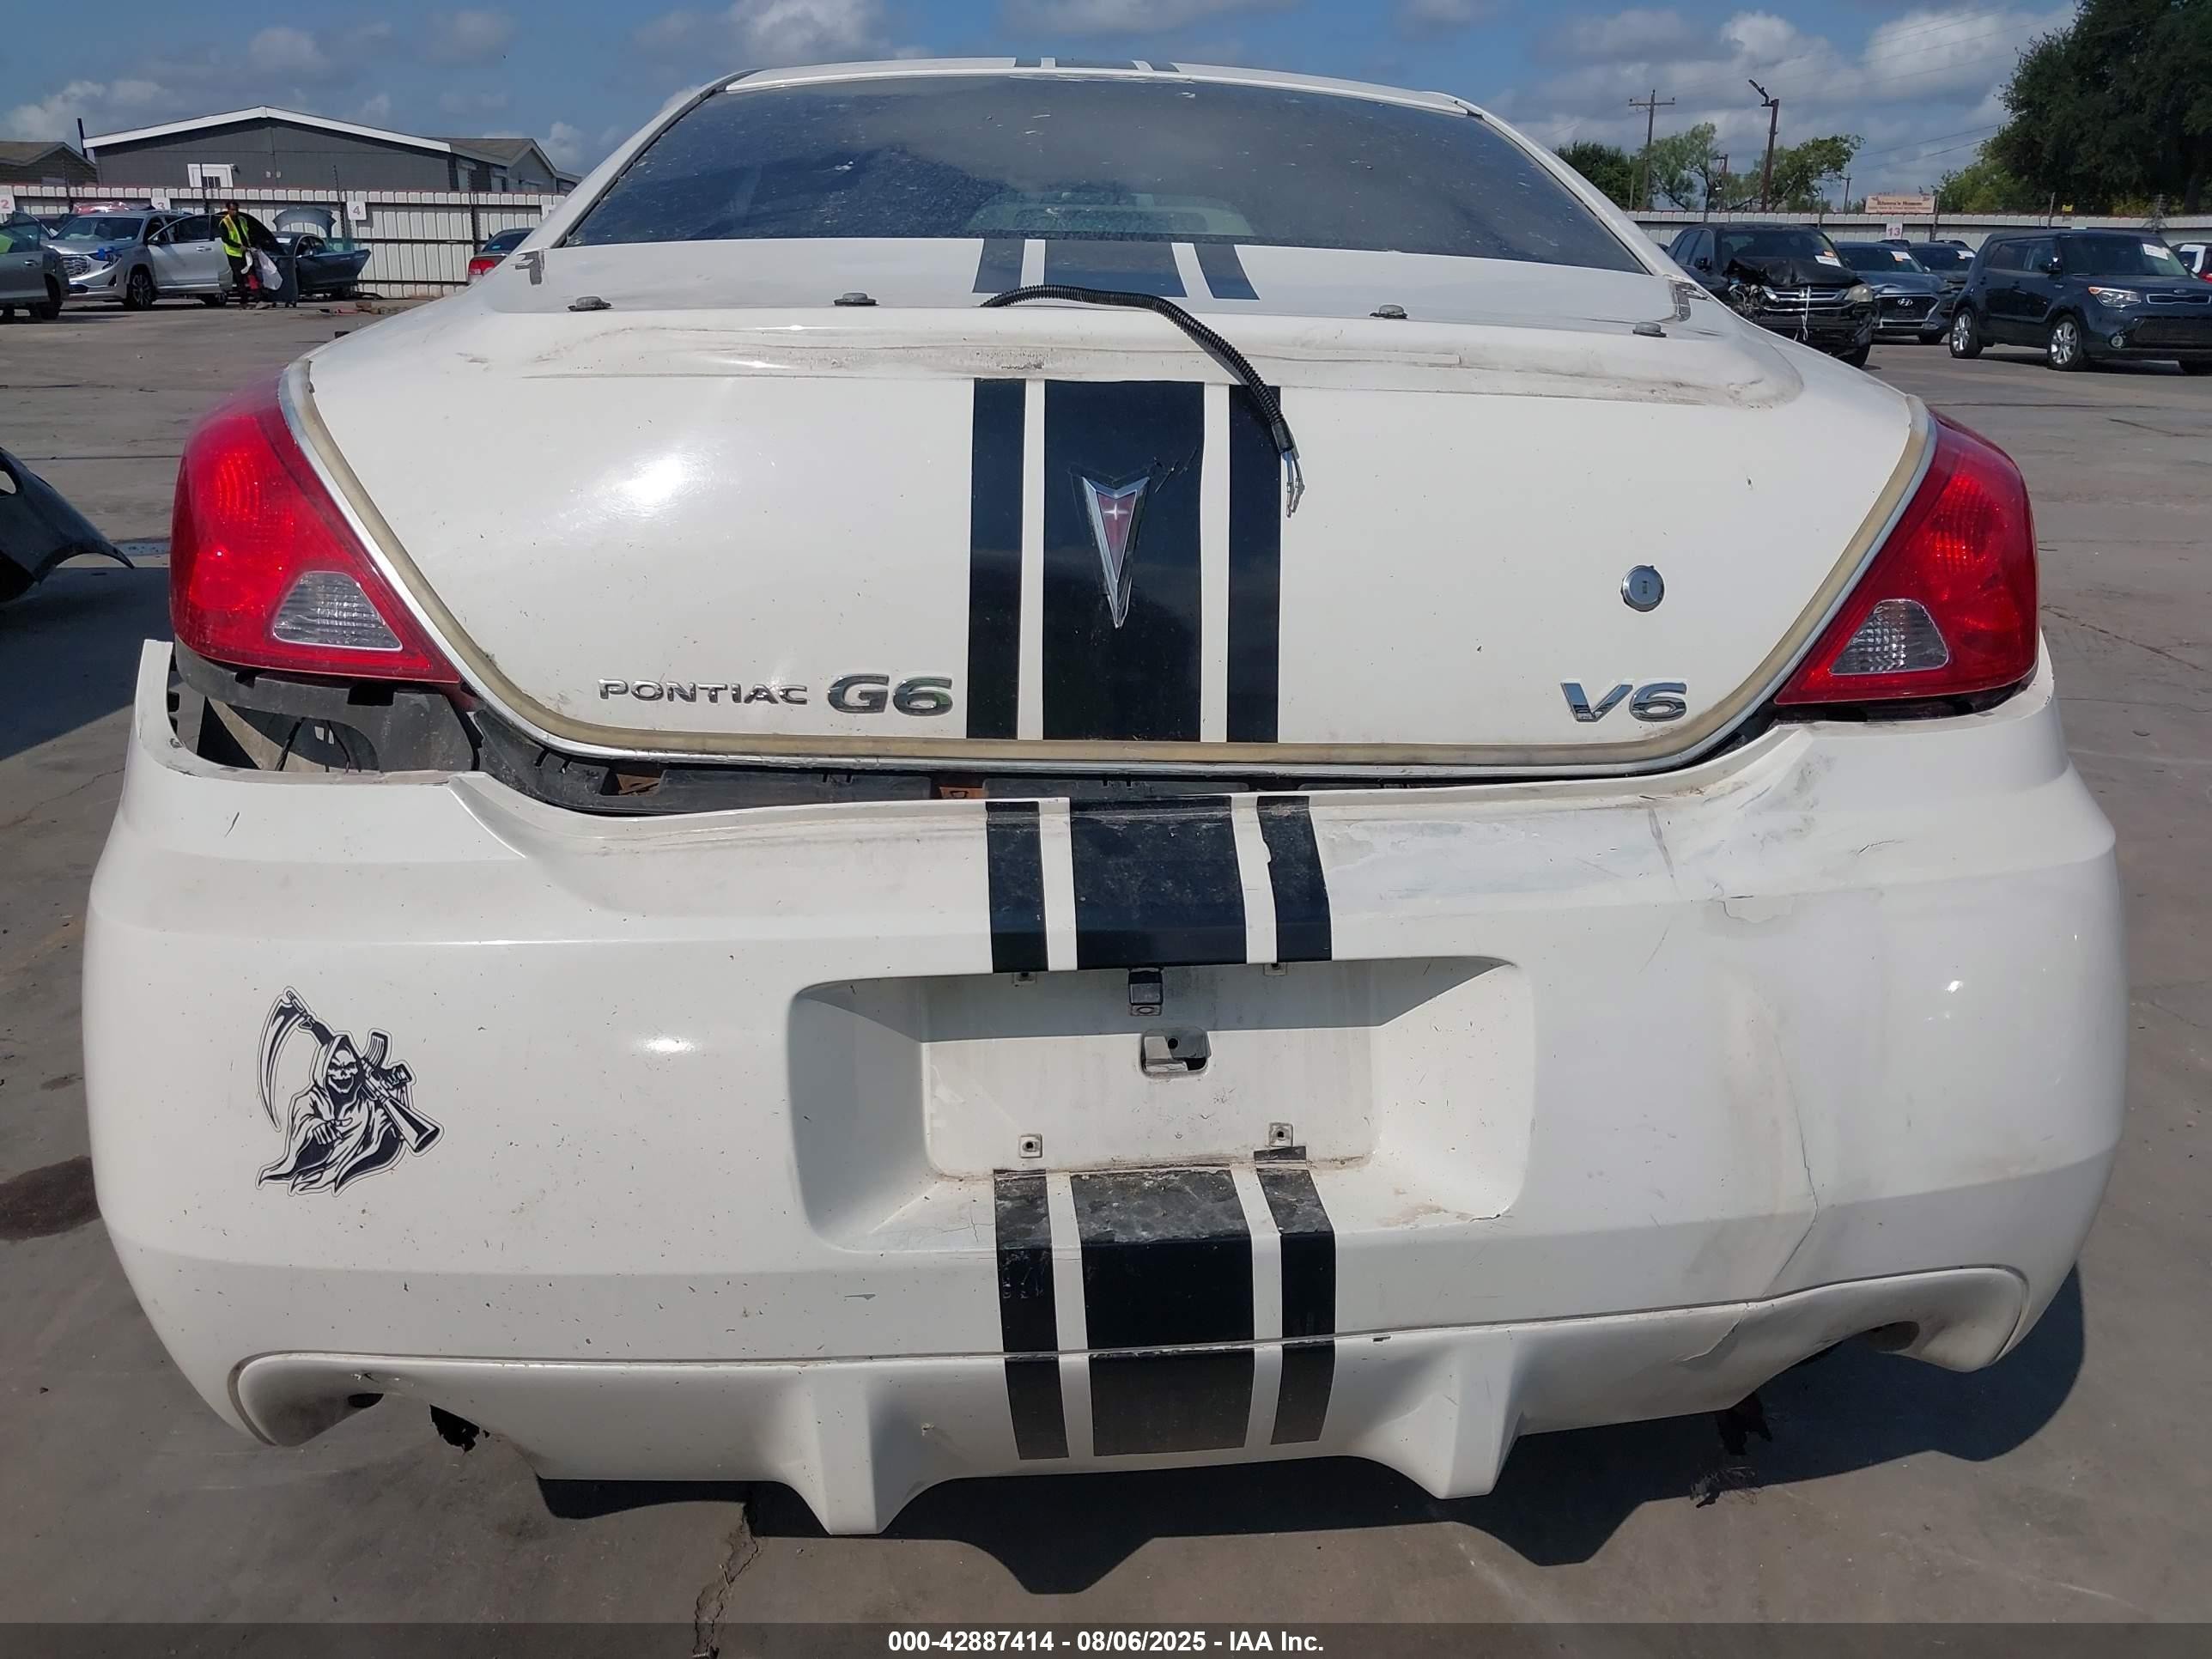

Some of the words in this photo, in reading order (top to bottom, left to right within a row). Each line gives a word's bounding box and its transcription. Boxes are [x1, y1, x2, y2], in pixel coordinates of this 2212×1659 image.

[1, 199, 9, 209] 2
[353, 206, 361, 216] 4
[1888, 228, 1900, 236] 13
[599, 678, 808, 704] PONTIAC
[828, 673, 953, 716] G6
[1560, 683, 1686, 722] V6
